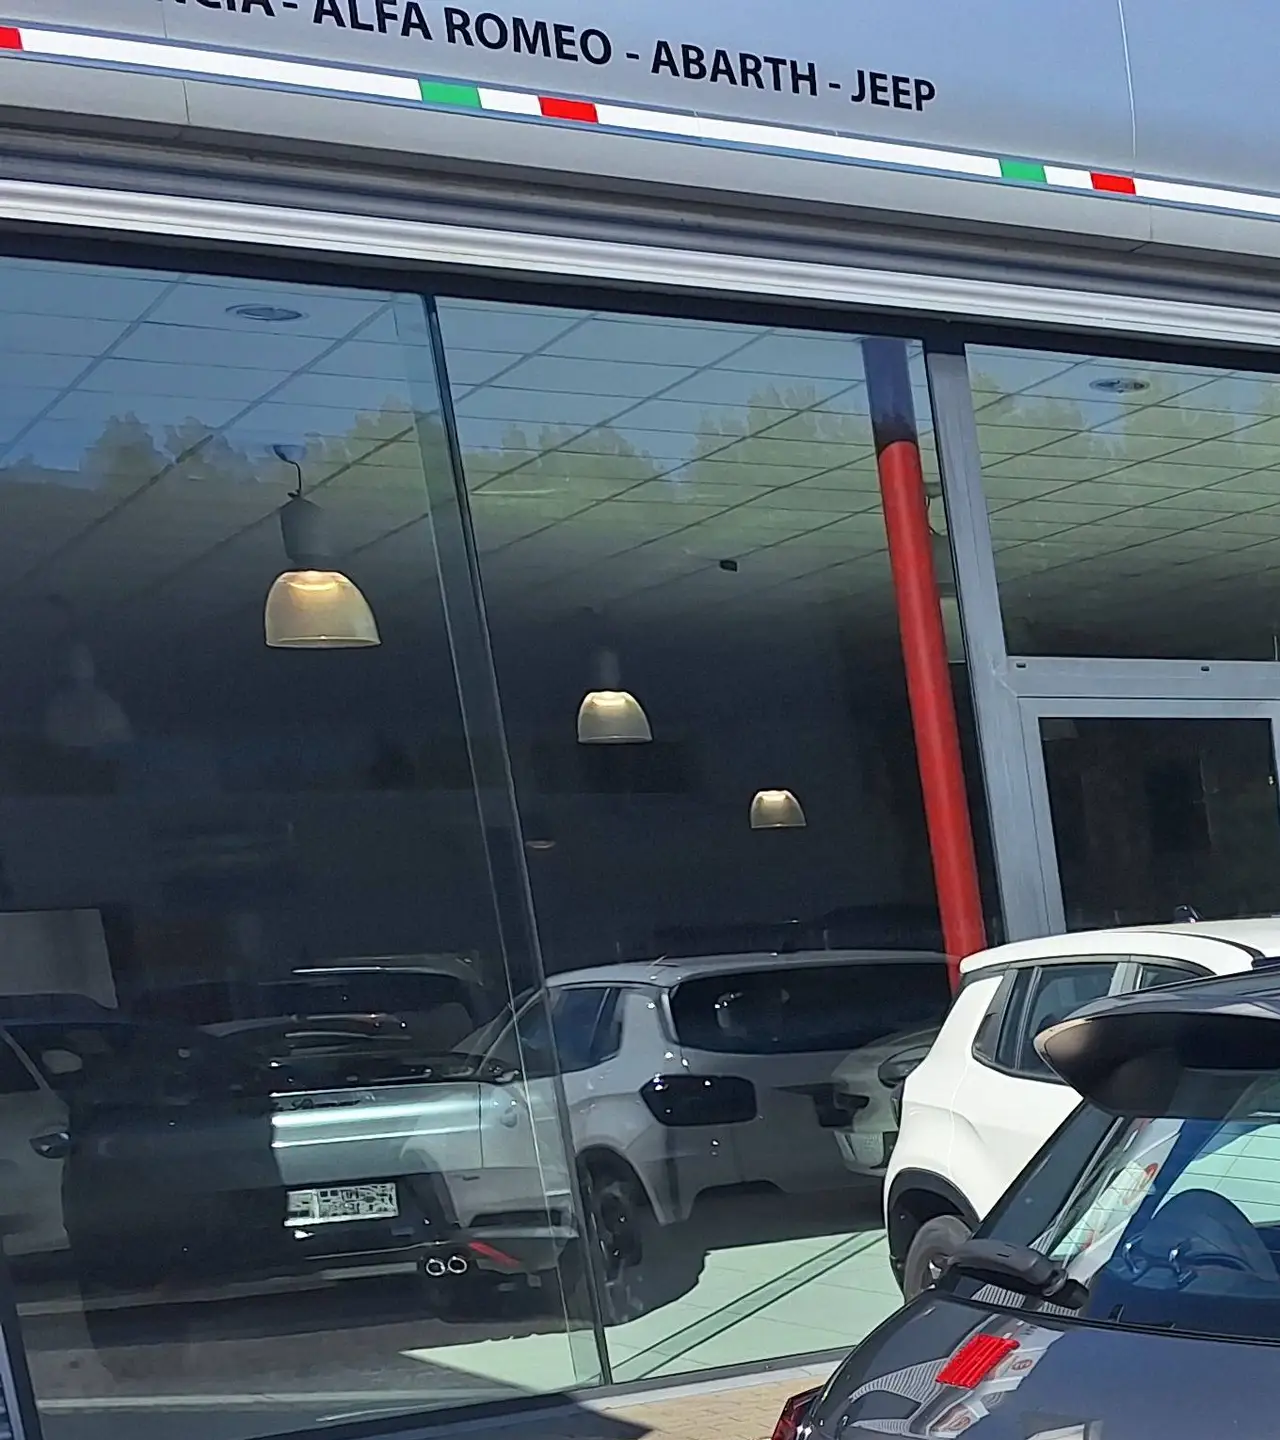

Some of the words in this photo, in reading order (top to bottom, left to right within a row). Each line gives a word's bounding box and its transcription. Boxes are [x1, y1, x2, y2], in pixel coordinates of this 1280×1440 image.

[313, 0, 433, 41] ALFA
[444, 6, 612, 65] ROMEO
[651, 40, 818, 97] ABARTH
[851, 69, 936, 112] JEEP
